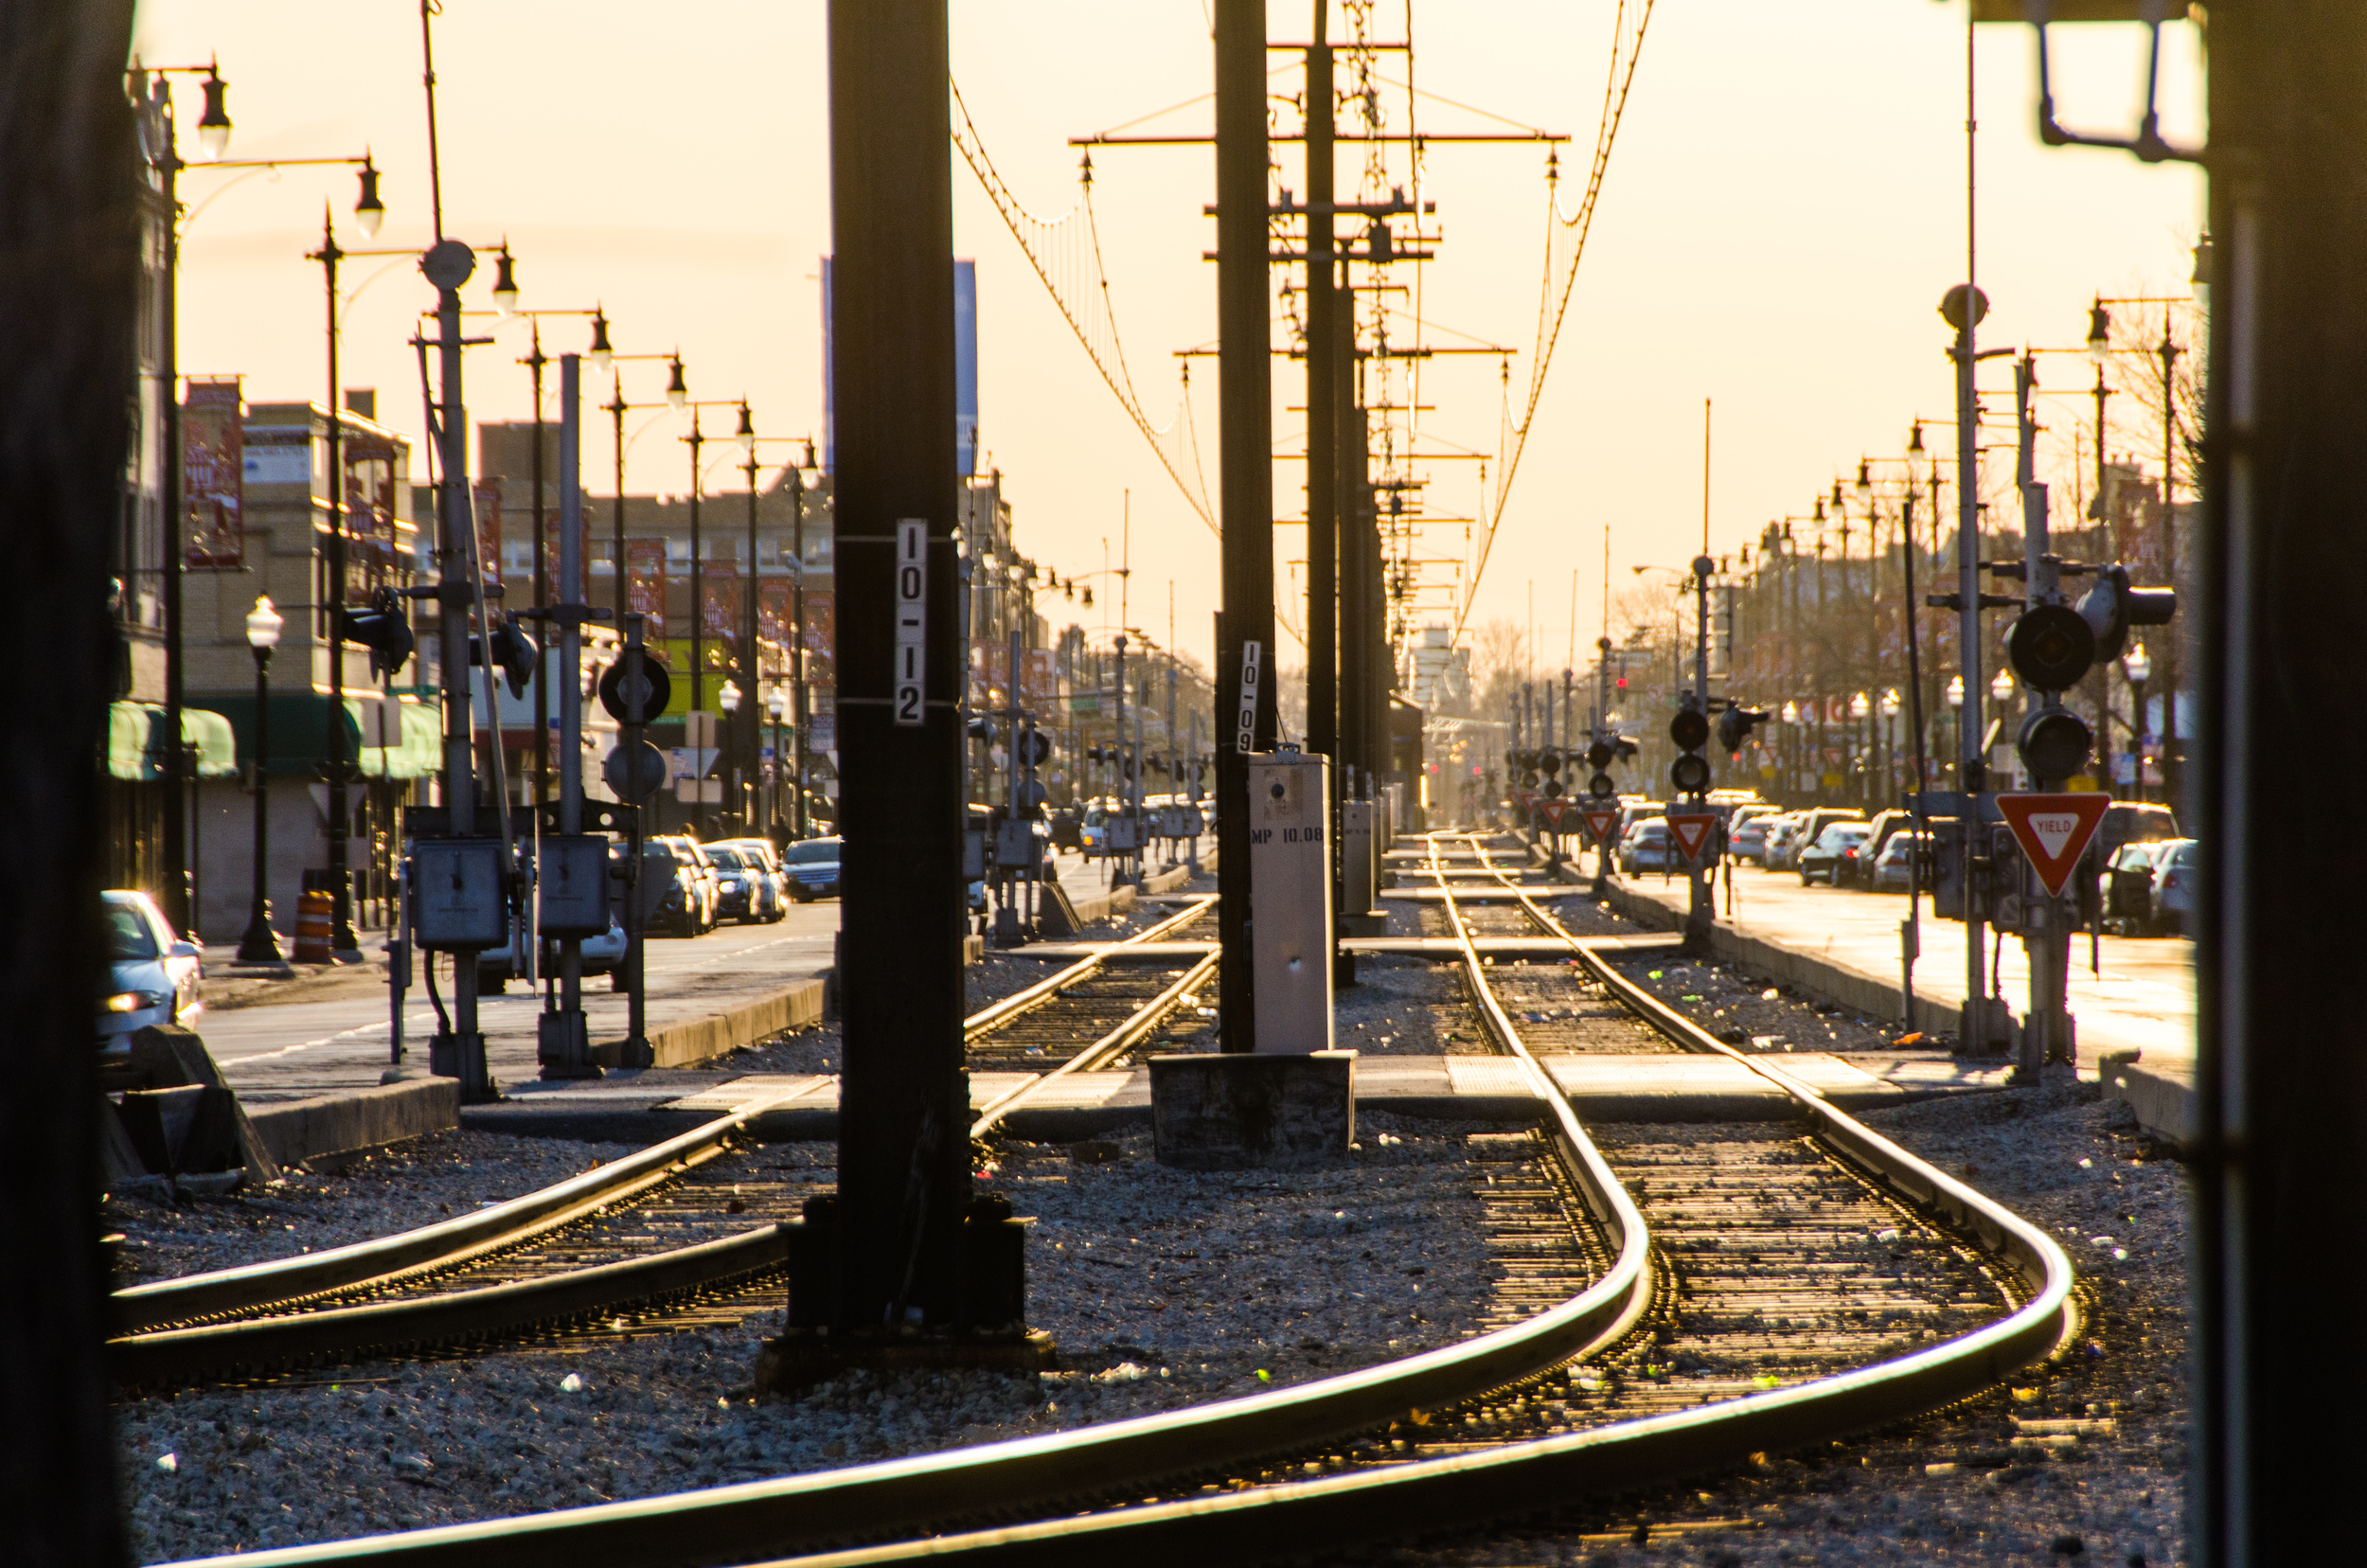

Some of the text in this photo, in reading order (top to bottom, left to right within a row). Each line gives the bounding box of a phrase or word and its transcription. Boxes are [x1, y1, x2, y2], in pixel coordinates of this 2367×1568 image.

[899, 526, 921, 720] 10-12
[1238, 644, 1255, 752] 10-09
[1251, 827, 1324, 845] MP 10.08
[2037, 820, 2072, 833] YIELD
